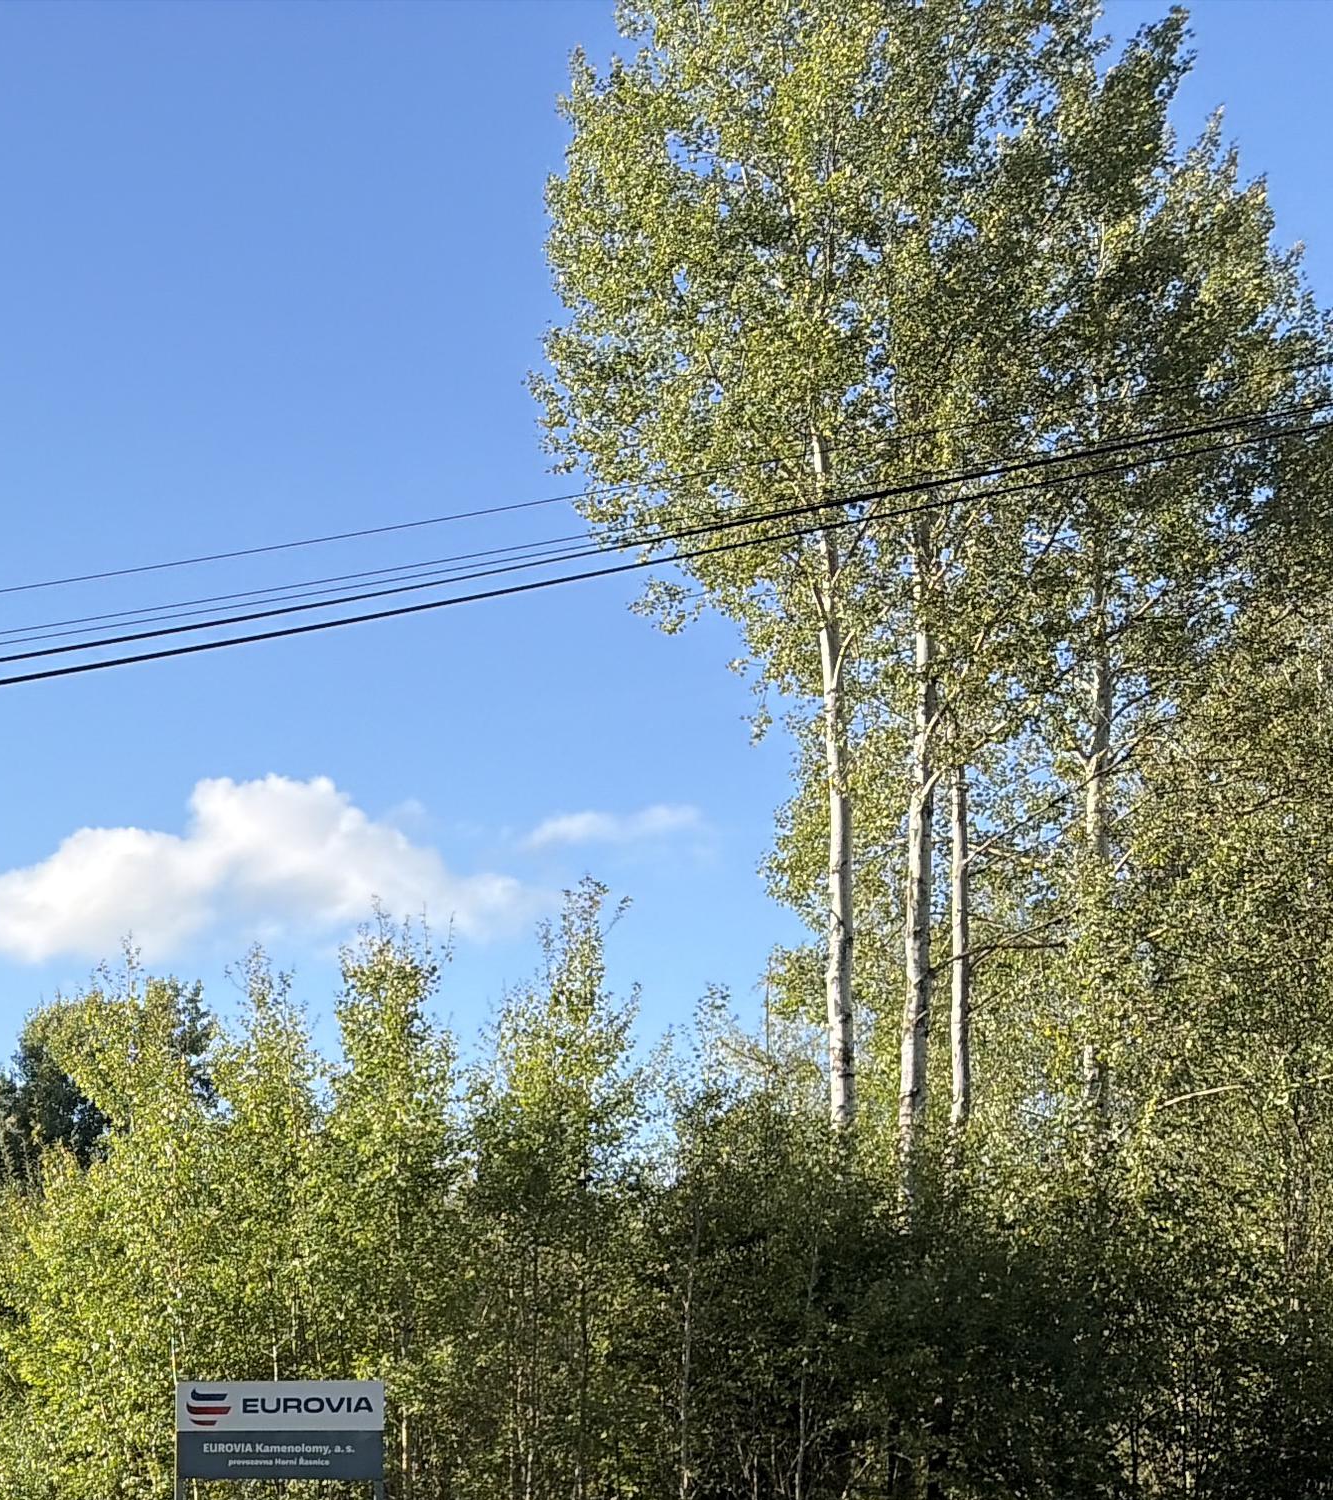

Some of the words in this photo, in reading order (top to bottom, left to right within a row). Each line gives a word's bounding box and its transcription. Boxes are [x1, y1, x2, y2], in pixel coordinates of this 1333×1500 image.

[242, 1397, 374, 1414] EUROVIA
[203, 1443, 253, 1453] EUROVIA
[255, 1443, 332, 1456] Kamenolomy,
[334, 1445, 344, 1453] a.
[345, 1445, 355, 1453] s.
[228, 1459, 273, 1467] provozovna
[299, 1456, 330, 1466] Řasnice
